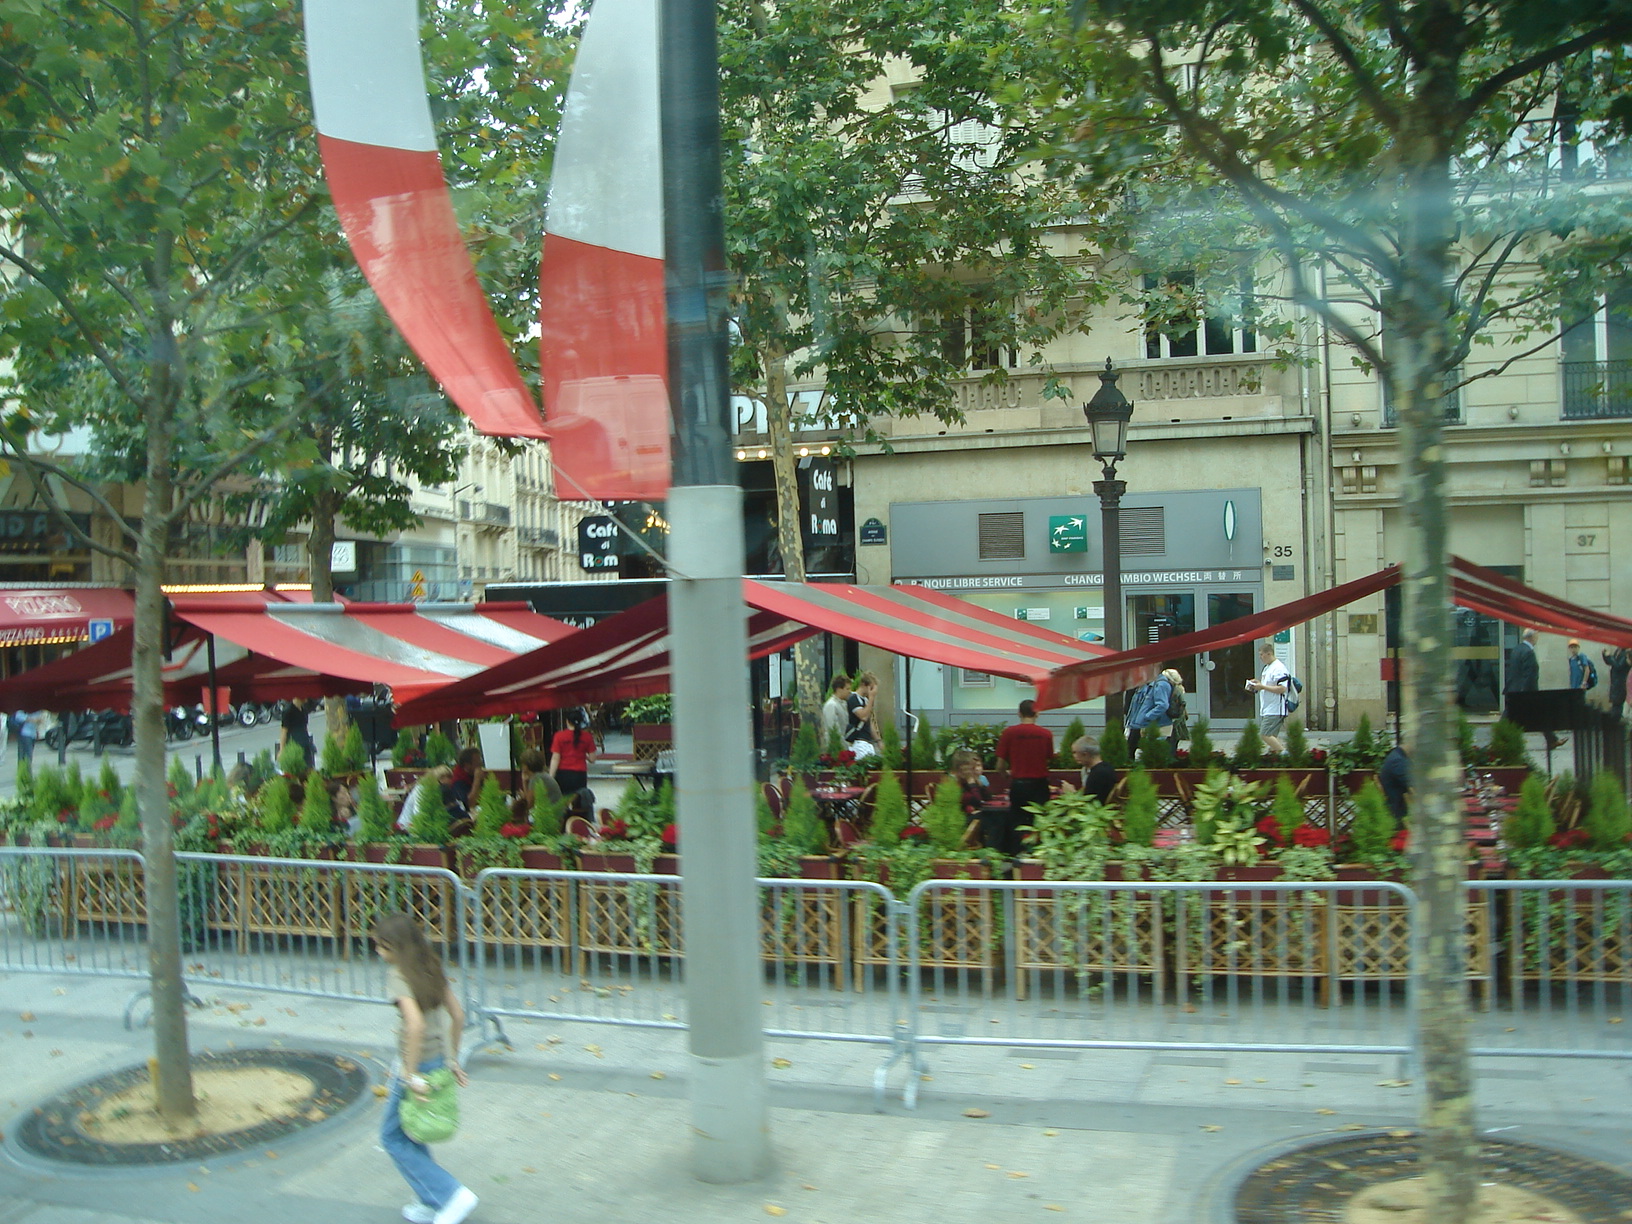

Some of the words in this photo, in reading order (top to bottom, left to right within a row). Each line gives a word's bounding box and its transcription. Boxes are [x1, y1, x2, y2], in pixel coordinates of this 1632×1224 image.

[811, 513, 837, 535] Roma
[1577, 534, 1597, 547] 37
[1274, 545, 1293, 558] 35
[583, 553, 619, 568] Rom
[953, 578, 981, 588] LIBRE
[982, 577, 1023, 587] SERVICE
[1152, 572, 1202, 582] WECHSEL
[96, 624, 107, 640] P
